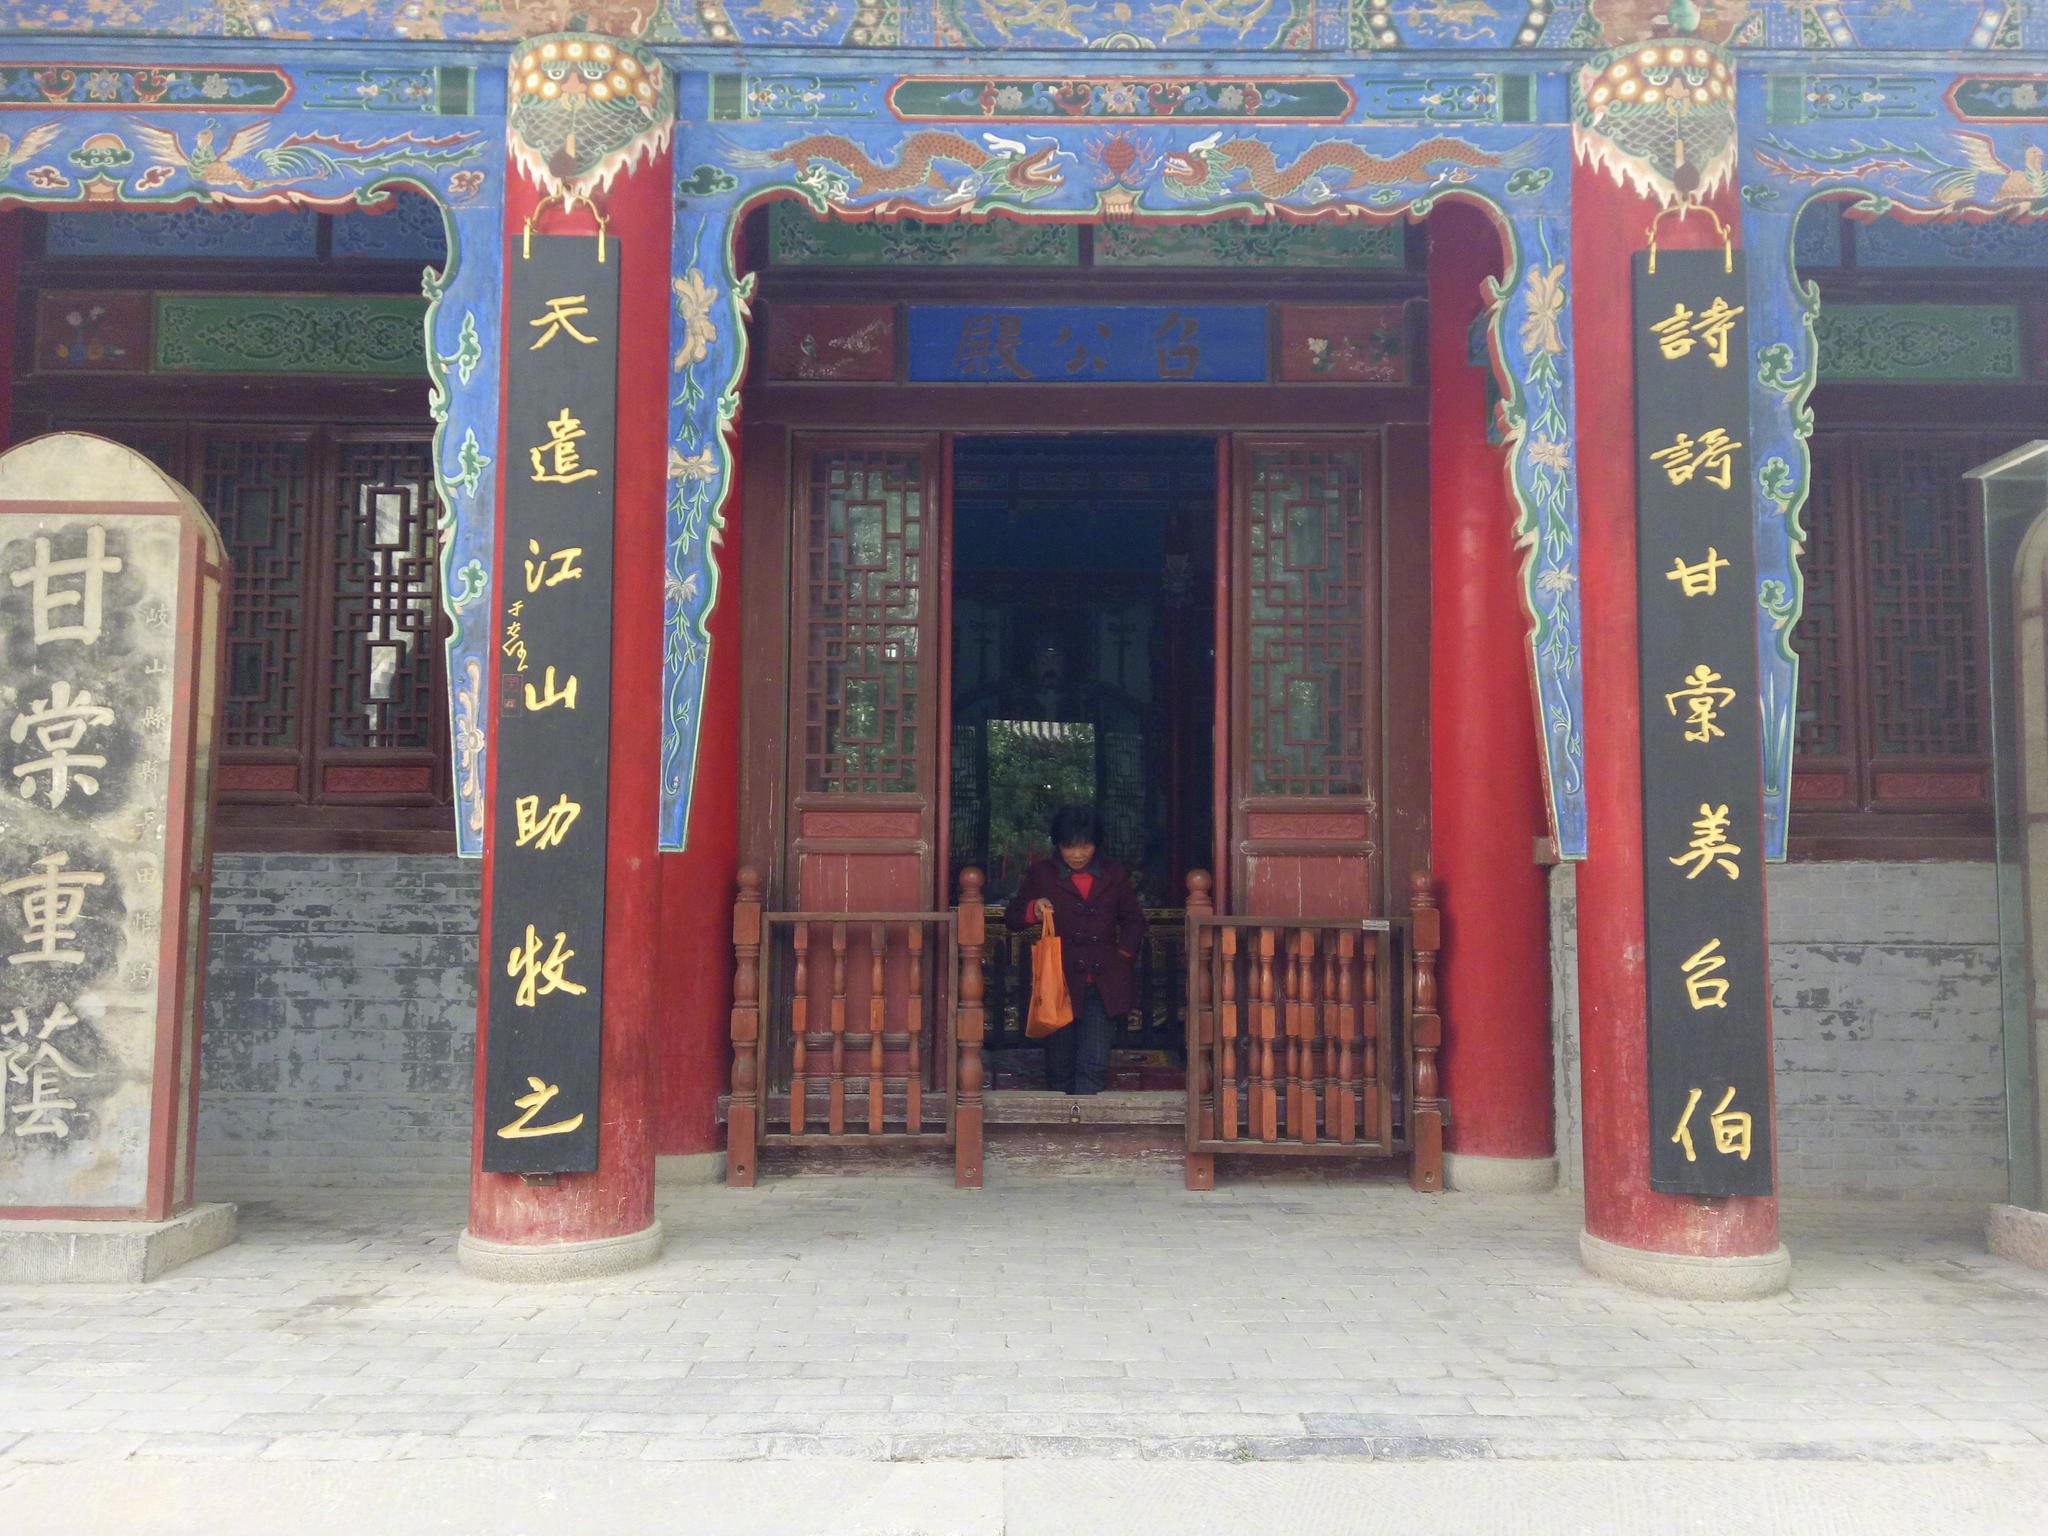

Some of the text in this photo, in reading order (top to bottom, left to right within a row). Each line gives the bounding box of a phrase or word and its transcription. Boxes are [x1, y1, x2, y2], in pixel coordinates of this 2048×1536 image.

[497, 295, 598, 1139] 天遣江山助牧之
